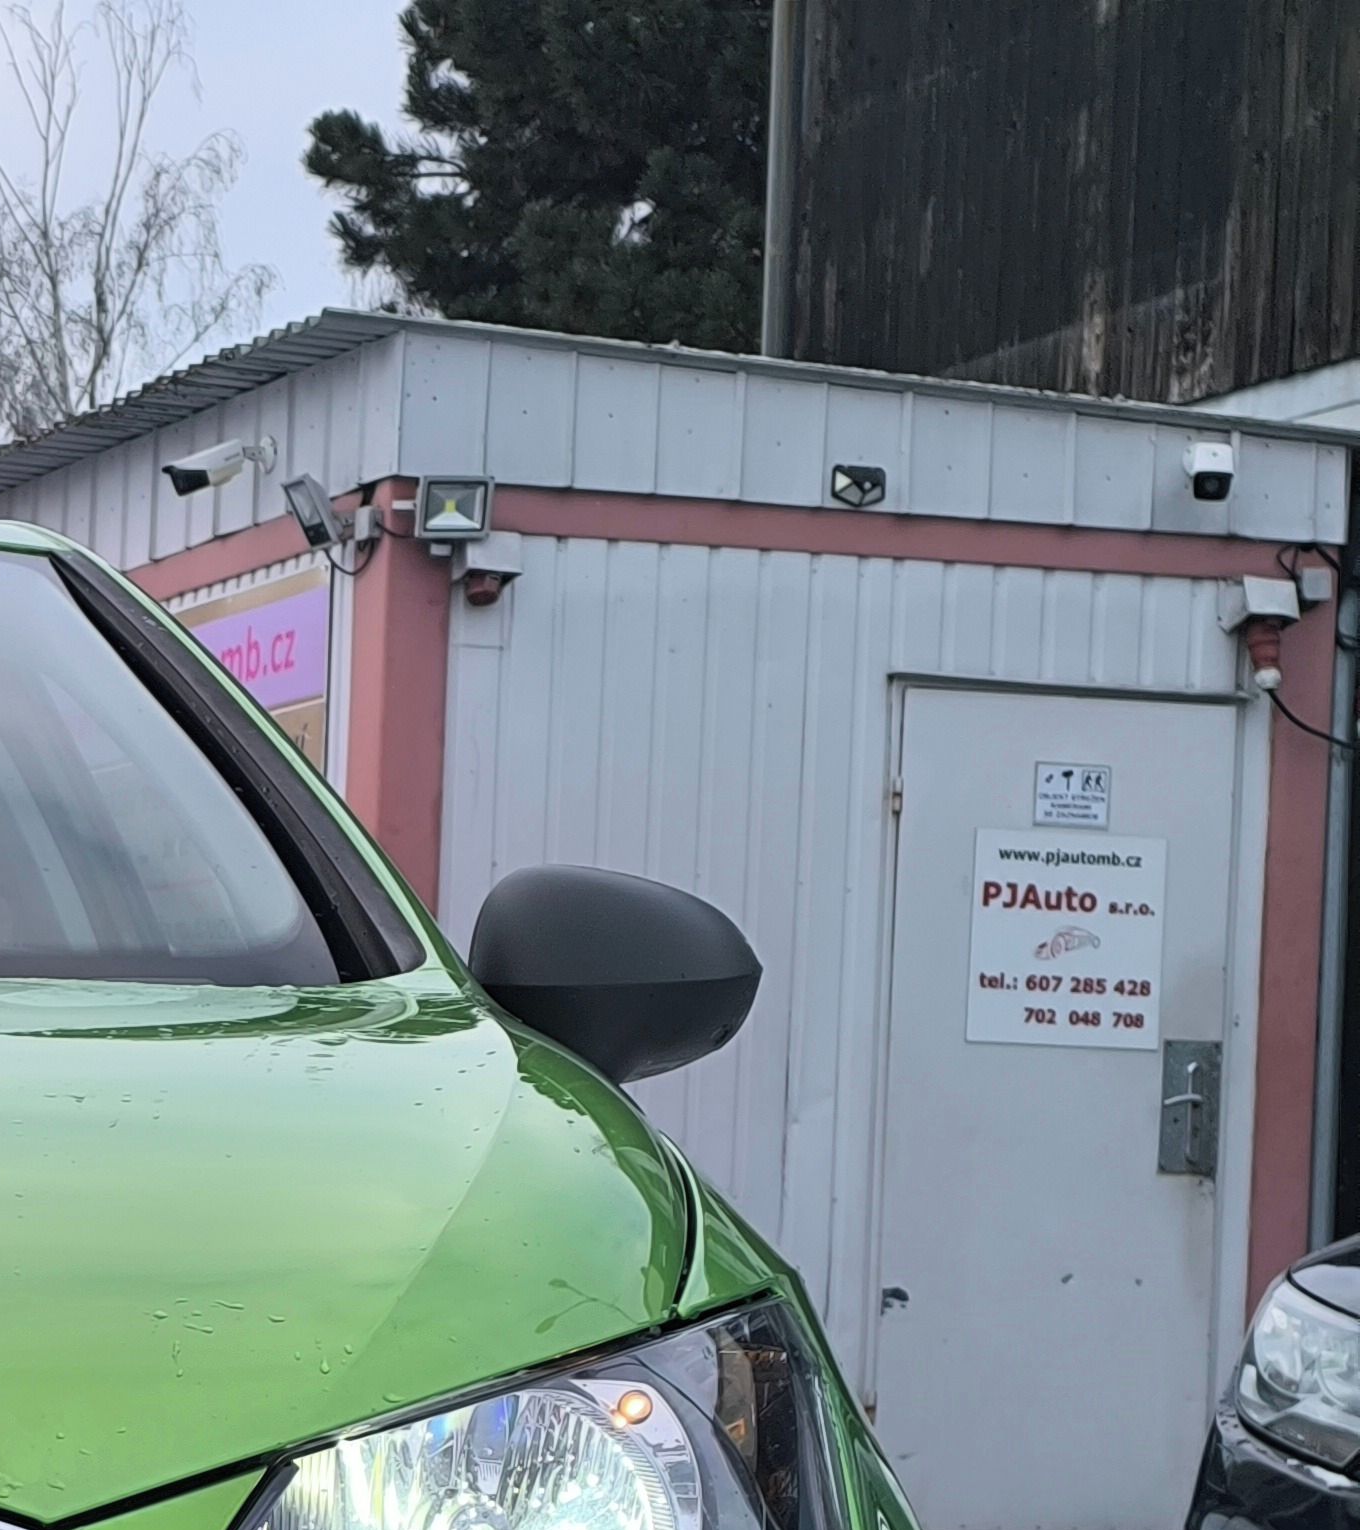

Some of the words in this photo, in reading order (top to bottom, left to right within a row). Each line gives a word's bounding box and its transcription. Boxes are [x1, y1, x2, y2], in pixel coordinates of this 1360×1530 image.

[998, 848, 1143, 868] www.pjautomb.cz
[982, 881, 1098, 913] PJAuto
[1108, 901, 1156, 917] s.r.o.
[979, 972, 1019, 991] tel.:
[1025, 974, 1063, 993] 607
[1069, 976, 1107, 995] 285
[1113, 979, 1151, 997] 428
[1023, 1006, 1057, 1025] 702
[1068, 1010, 1101, 1027] 048
[1112, 1011, 1145, 1029] 708
